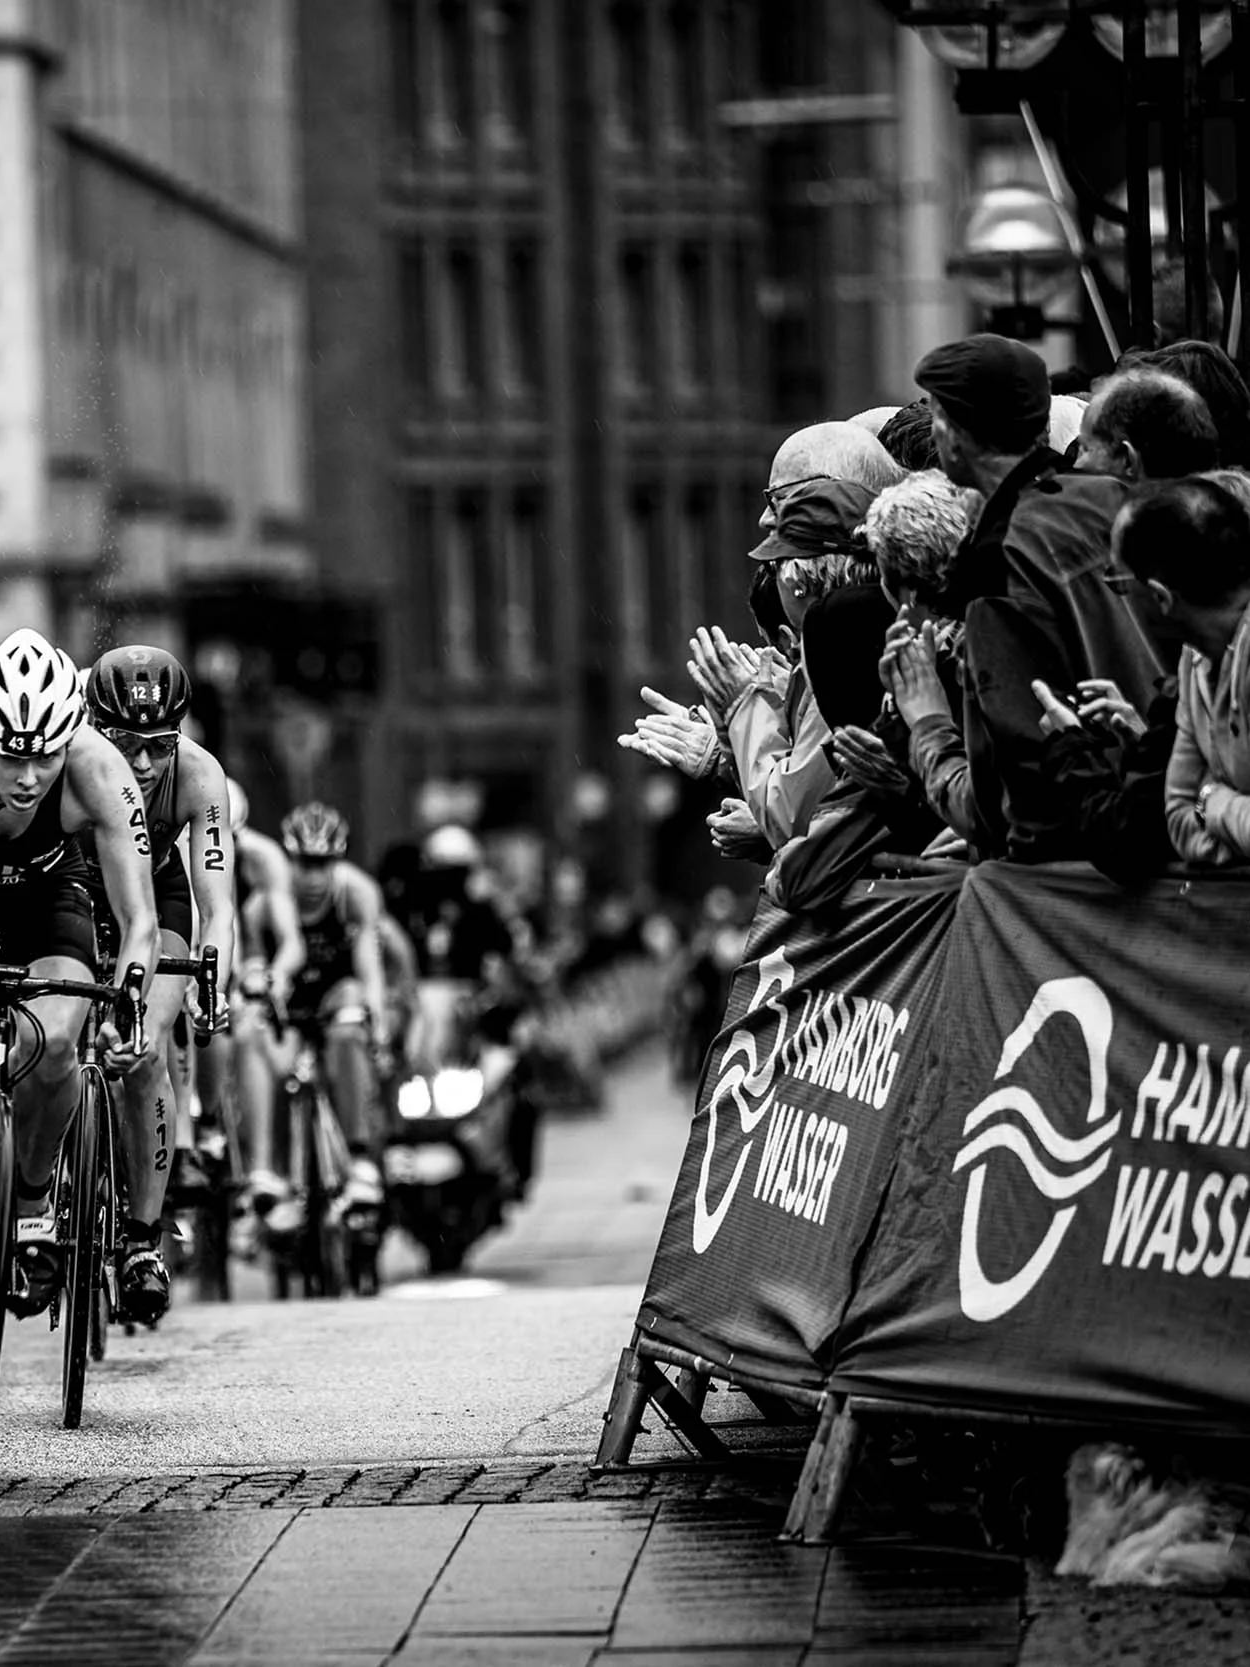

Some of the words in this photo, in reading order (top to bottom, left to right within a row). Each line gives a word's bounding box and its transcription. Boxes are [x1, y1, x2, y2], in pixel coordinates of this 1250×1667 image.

[131, 686, 147, 699] 12
[8, 736, 25, 750] 43
[129, 807, 152, 857] 43
[204, 826, 226, 872] 12
[783, 989, 910, 1111] HAMBURG
[154, 1123, 168, 1172] 12
[754, 1100, 848, 1226] WASSER
